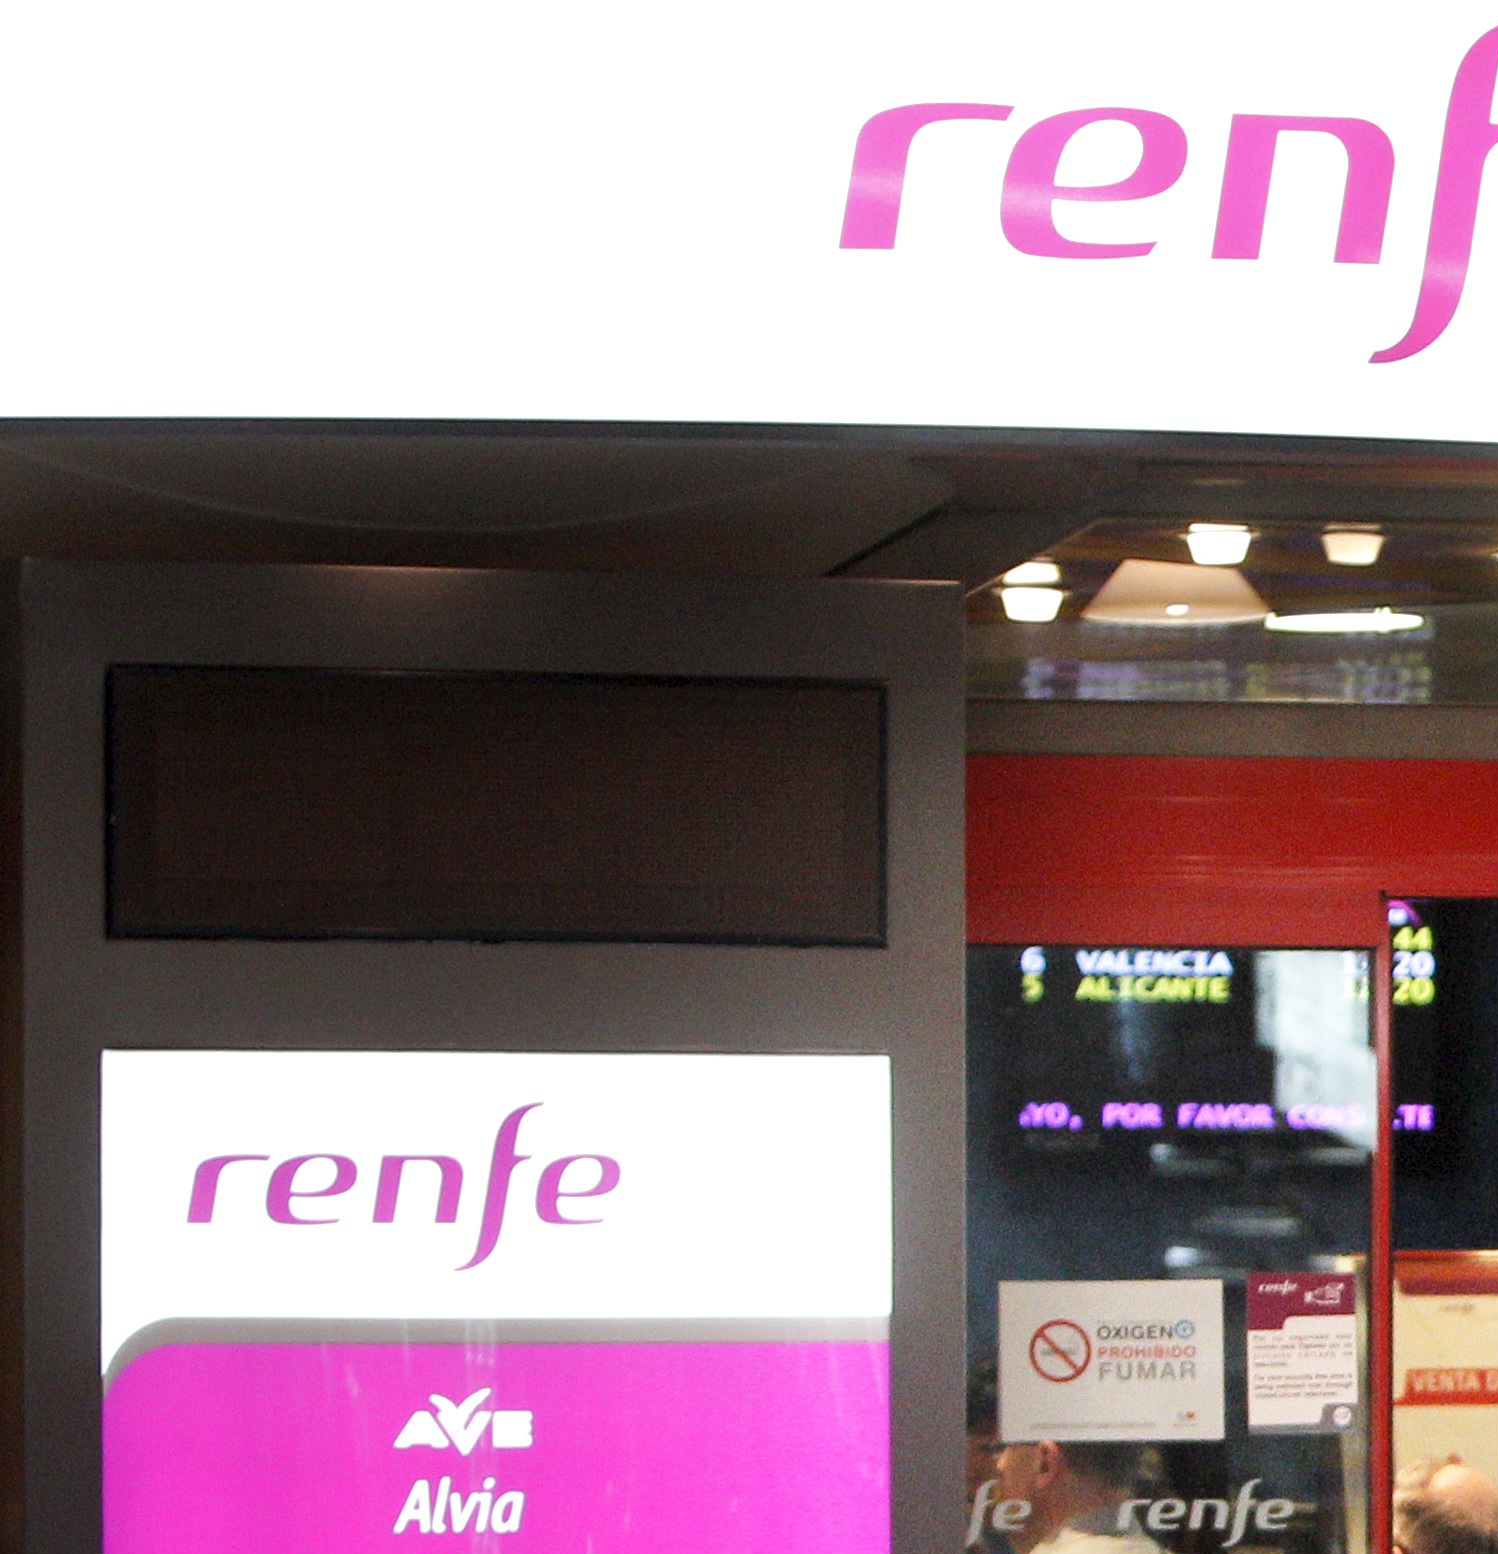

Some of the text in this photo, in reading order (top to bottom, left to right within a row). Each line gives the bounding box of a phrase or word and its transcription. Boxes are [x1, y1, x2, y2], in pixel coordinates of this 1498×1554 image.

[1076, 949, 1234, 977] VALENCIA
[1075, 976, 1232, 1004] ALICANTE
[1102, 1102, 1164, 1130] POR
[1176, 1102, 1275, 1131] FAVOR
[187, 1102, 622, 1272] renfe
[1098, 1361, 1196, 1381] FUMAR
[393, 1476, 525, 1535] Alvia
[1117, 1478, 1295, 1548] renfe
